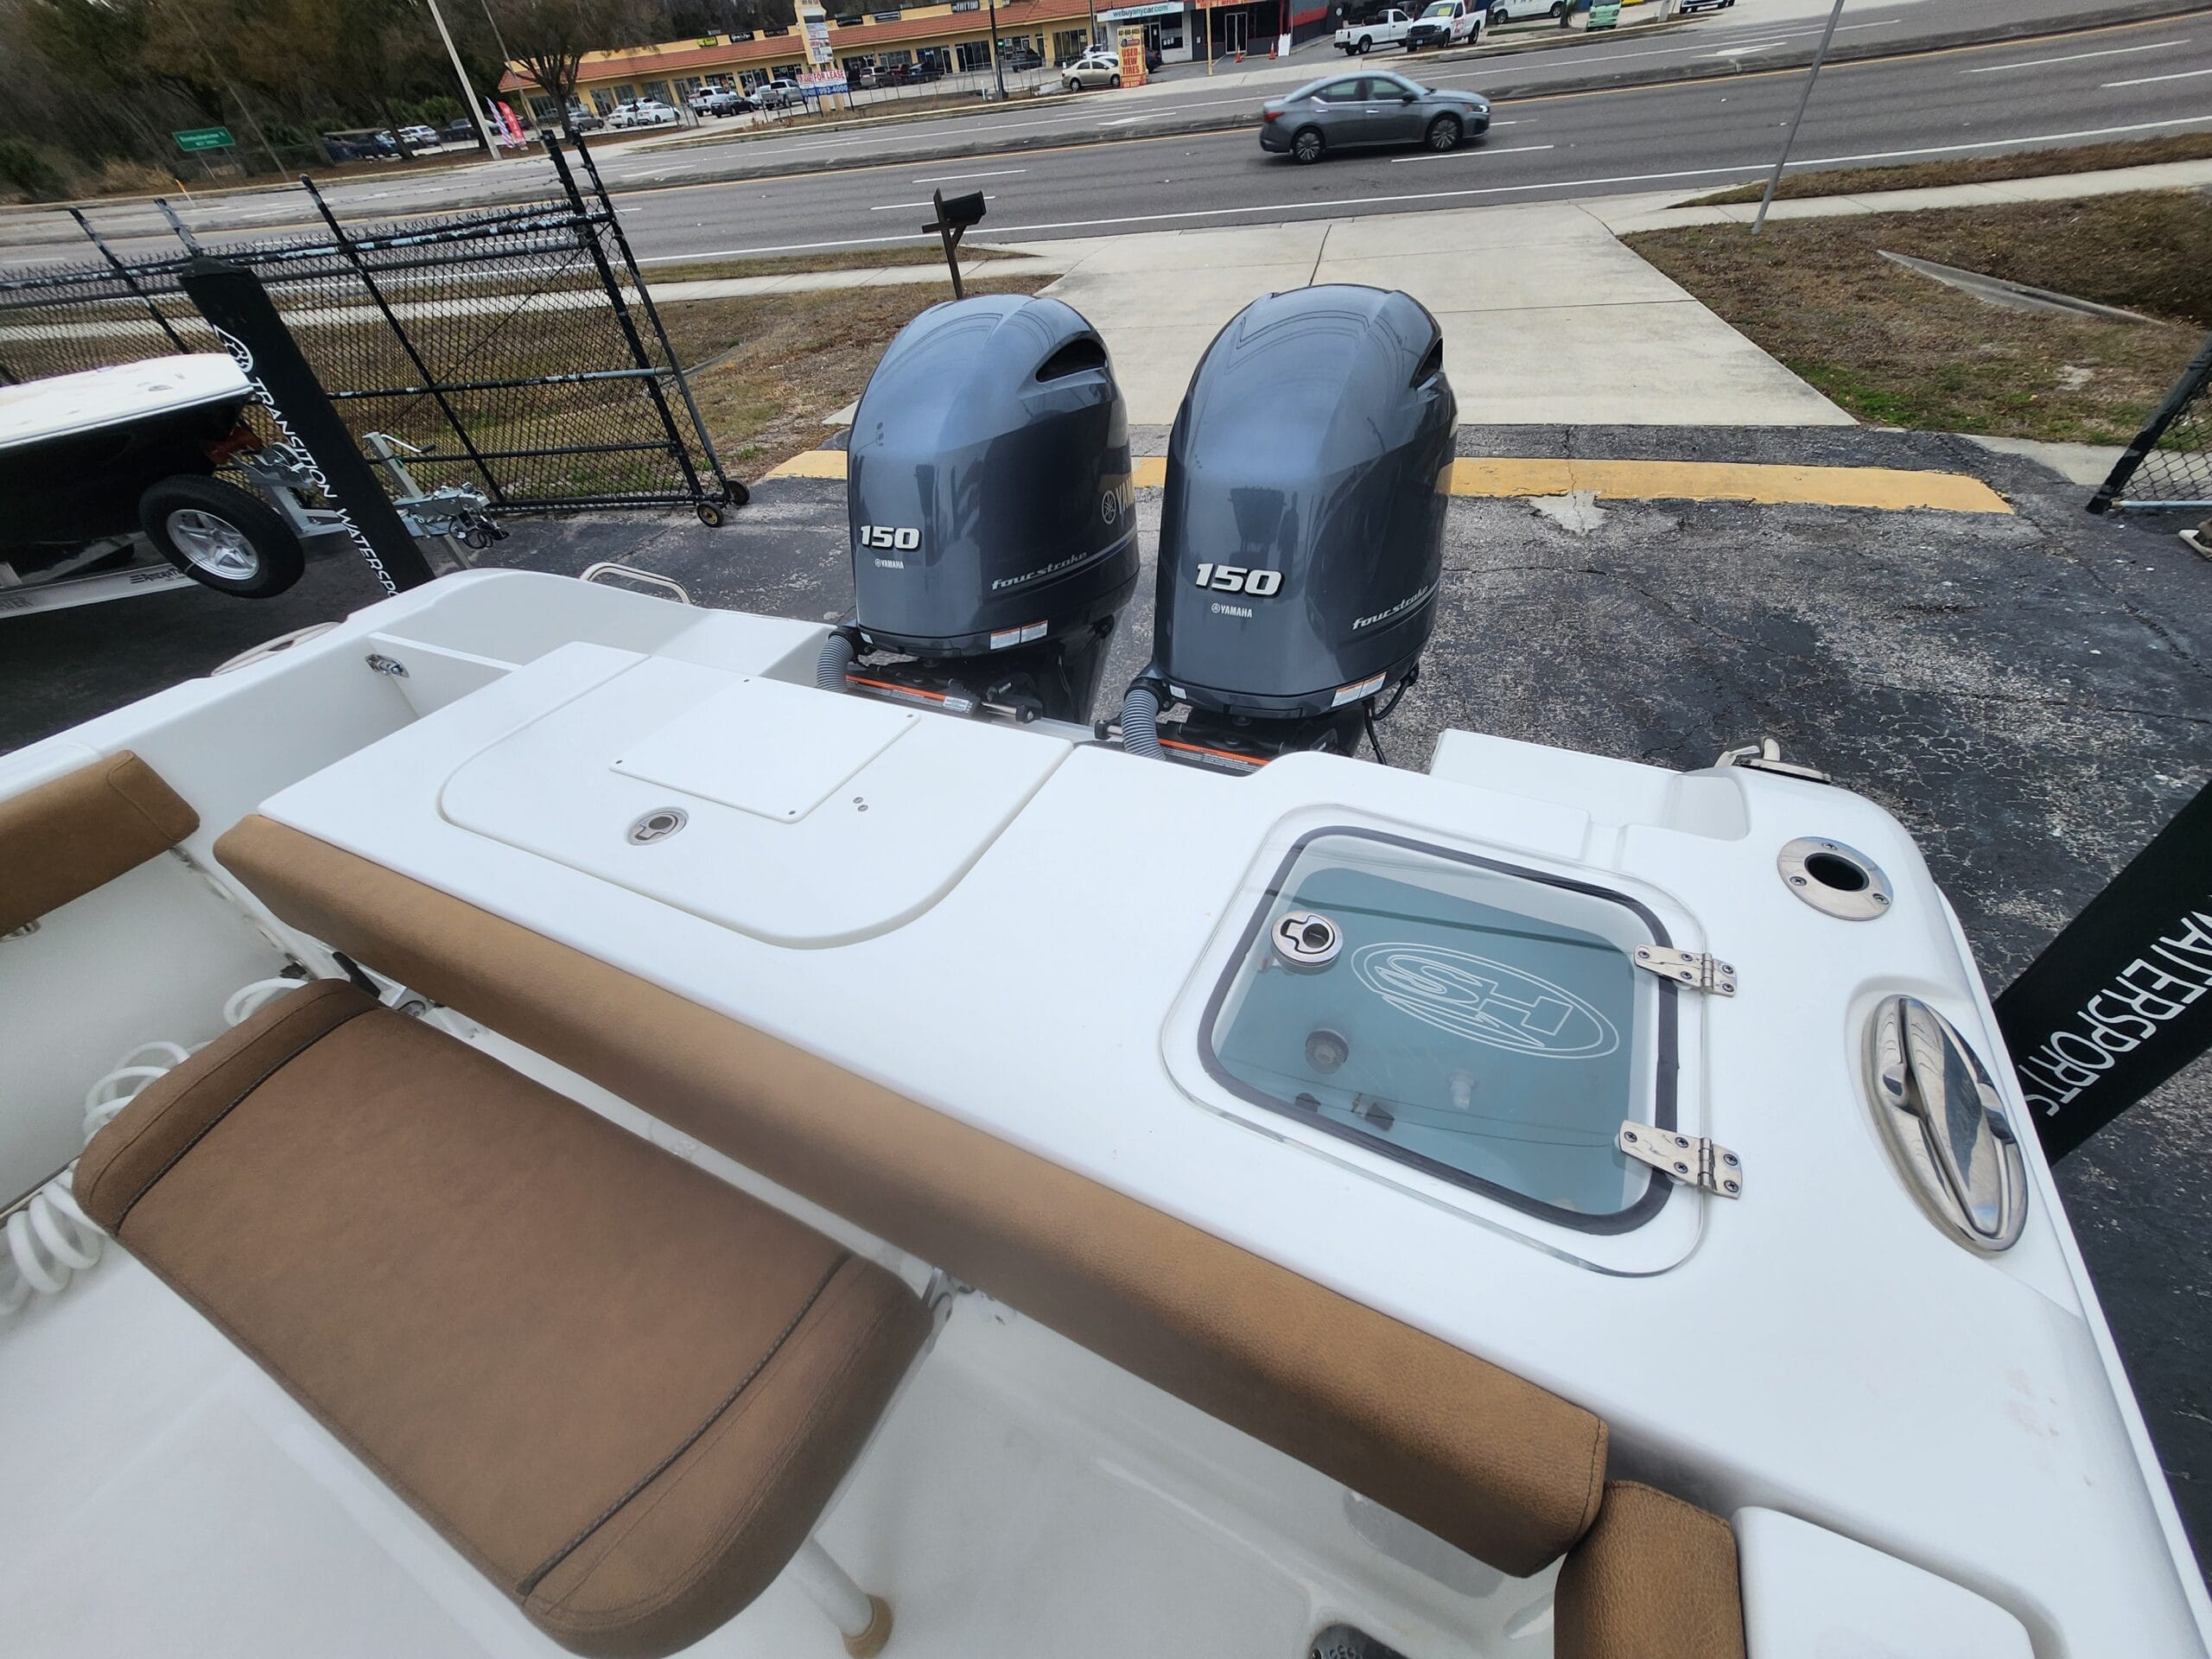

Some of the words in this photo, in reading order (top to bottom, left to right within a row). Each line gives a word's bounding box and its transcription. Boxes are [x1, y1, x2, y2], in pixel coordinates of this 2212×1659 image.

[1113, 4, 1168, 18] webuyanycar.com
[1122, 48, 1138, 56] USED
[1122, 56, 1137, 66] NEW
[814, 73, 825, 81] FOR
[827, 70, 845, 79] LEASE
[1122, 66, 1140, 75] TIRES
[251, 377, 338, 499] TRANSITION
[861, 525, 921, 550] 150
[881, 560, 905, 569] YAMAHA
[1196, 563, 1283, 596] 150
[1221, 604, 1253, 619] YAMAHA
